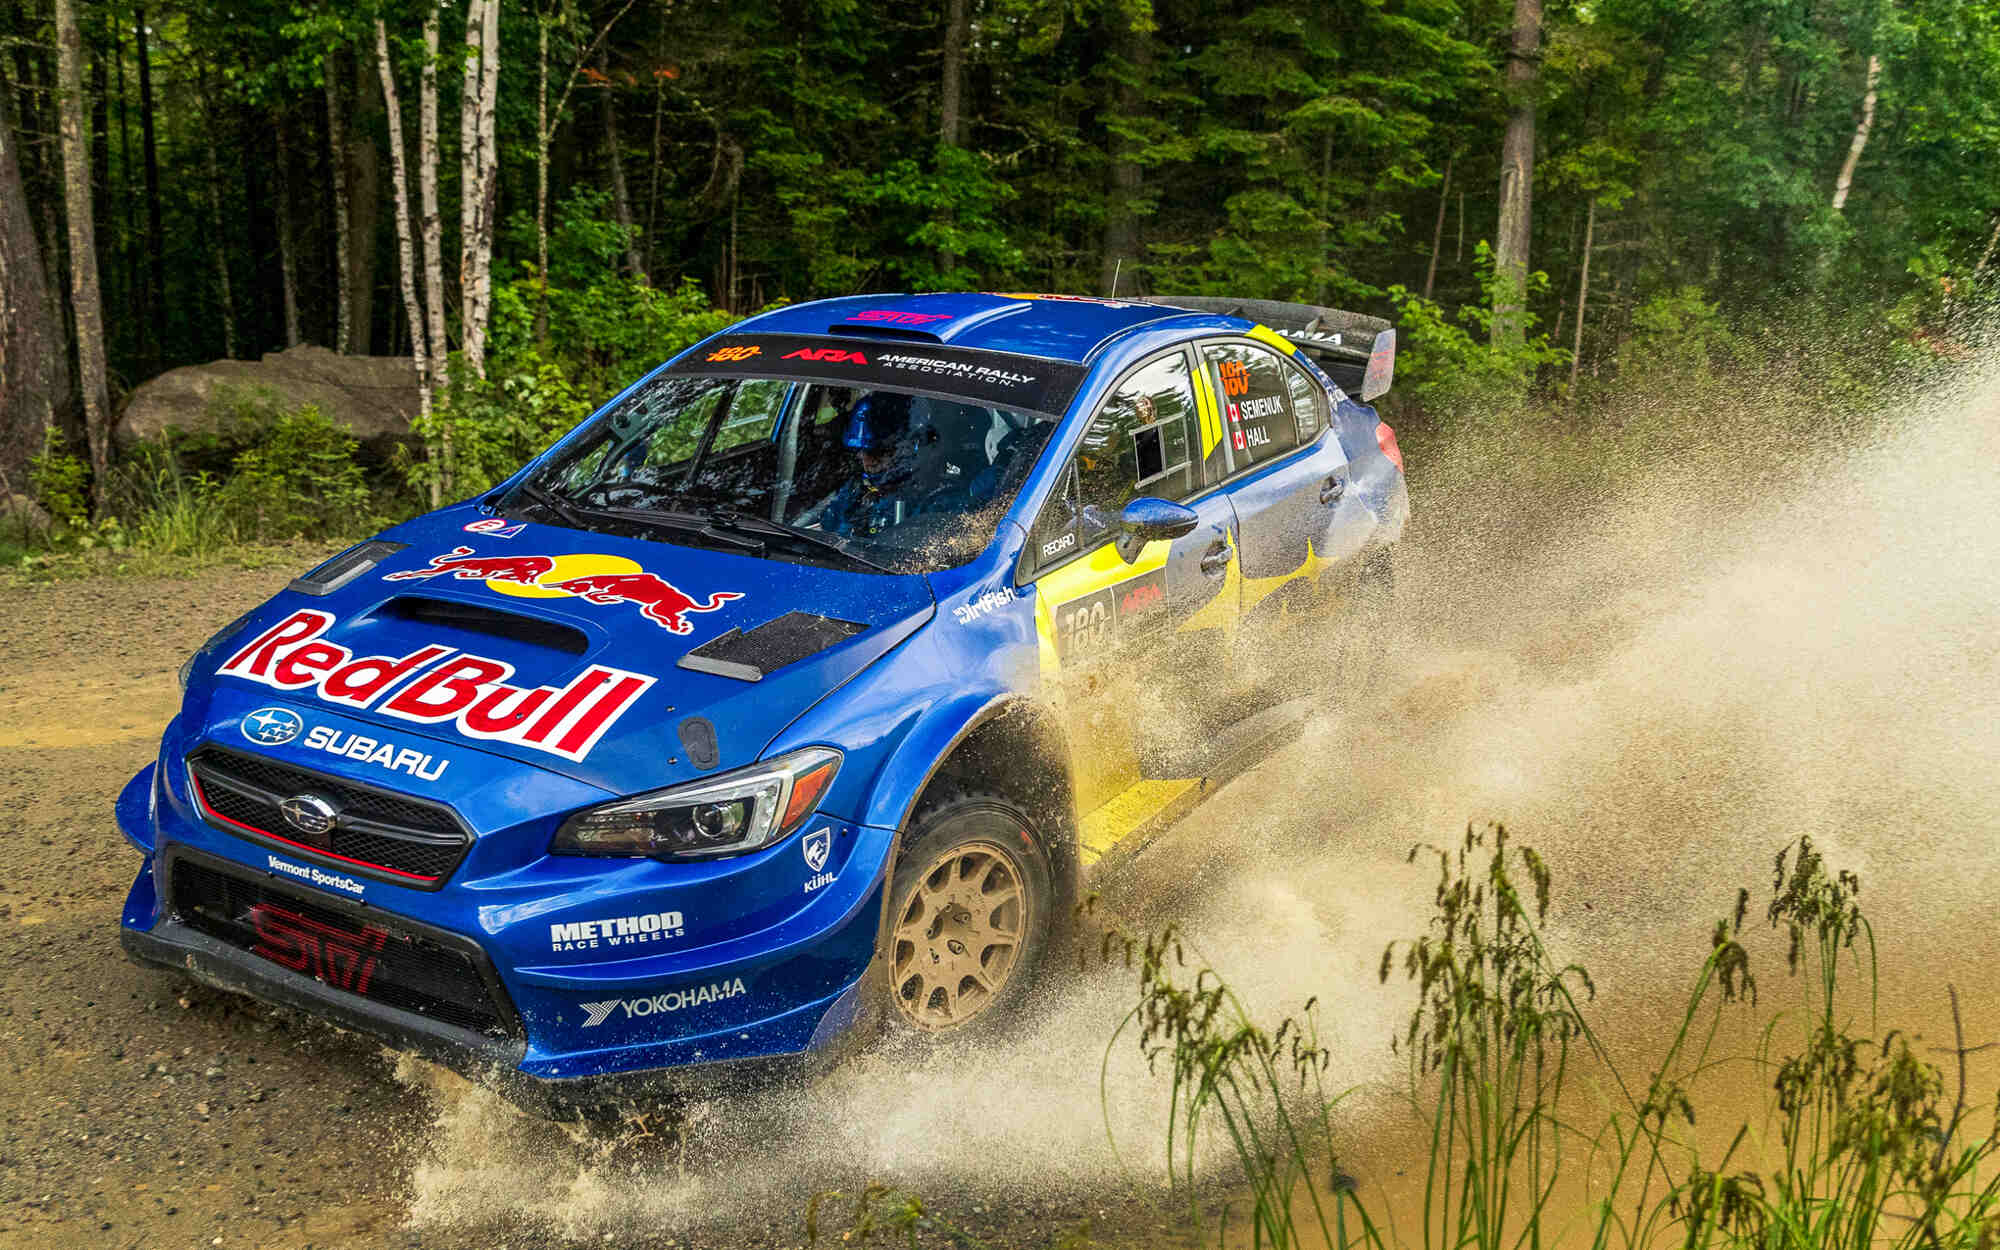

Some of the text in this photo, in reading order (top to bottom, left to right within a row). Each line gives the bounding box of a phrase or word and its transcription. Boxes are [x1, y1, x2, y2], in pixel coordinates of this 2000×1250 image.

[780, 347, 868, 365] ARA
[877, 354, 1037, 384] AMERICAN RALLY
[1240, 395, 1284, 420] SEMENUK
[1246, 425, 1271, 447] HALL
[219, 610, 652, 758] Red Bull
[303, 725, 450, 782] SUBARU
[267, 855, 365, 894] Vermont SportsCar
[550, 911, 684, 943] METHOD
[552, 928, 685, 952] RACE WHEELS
[620, 977, 747, 1019] YOKOHAMA
